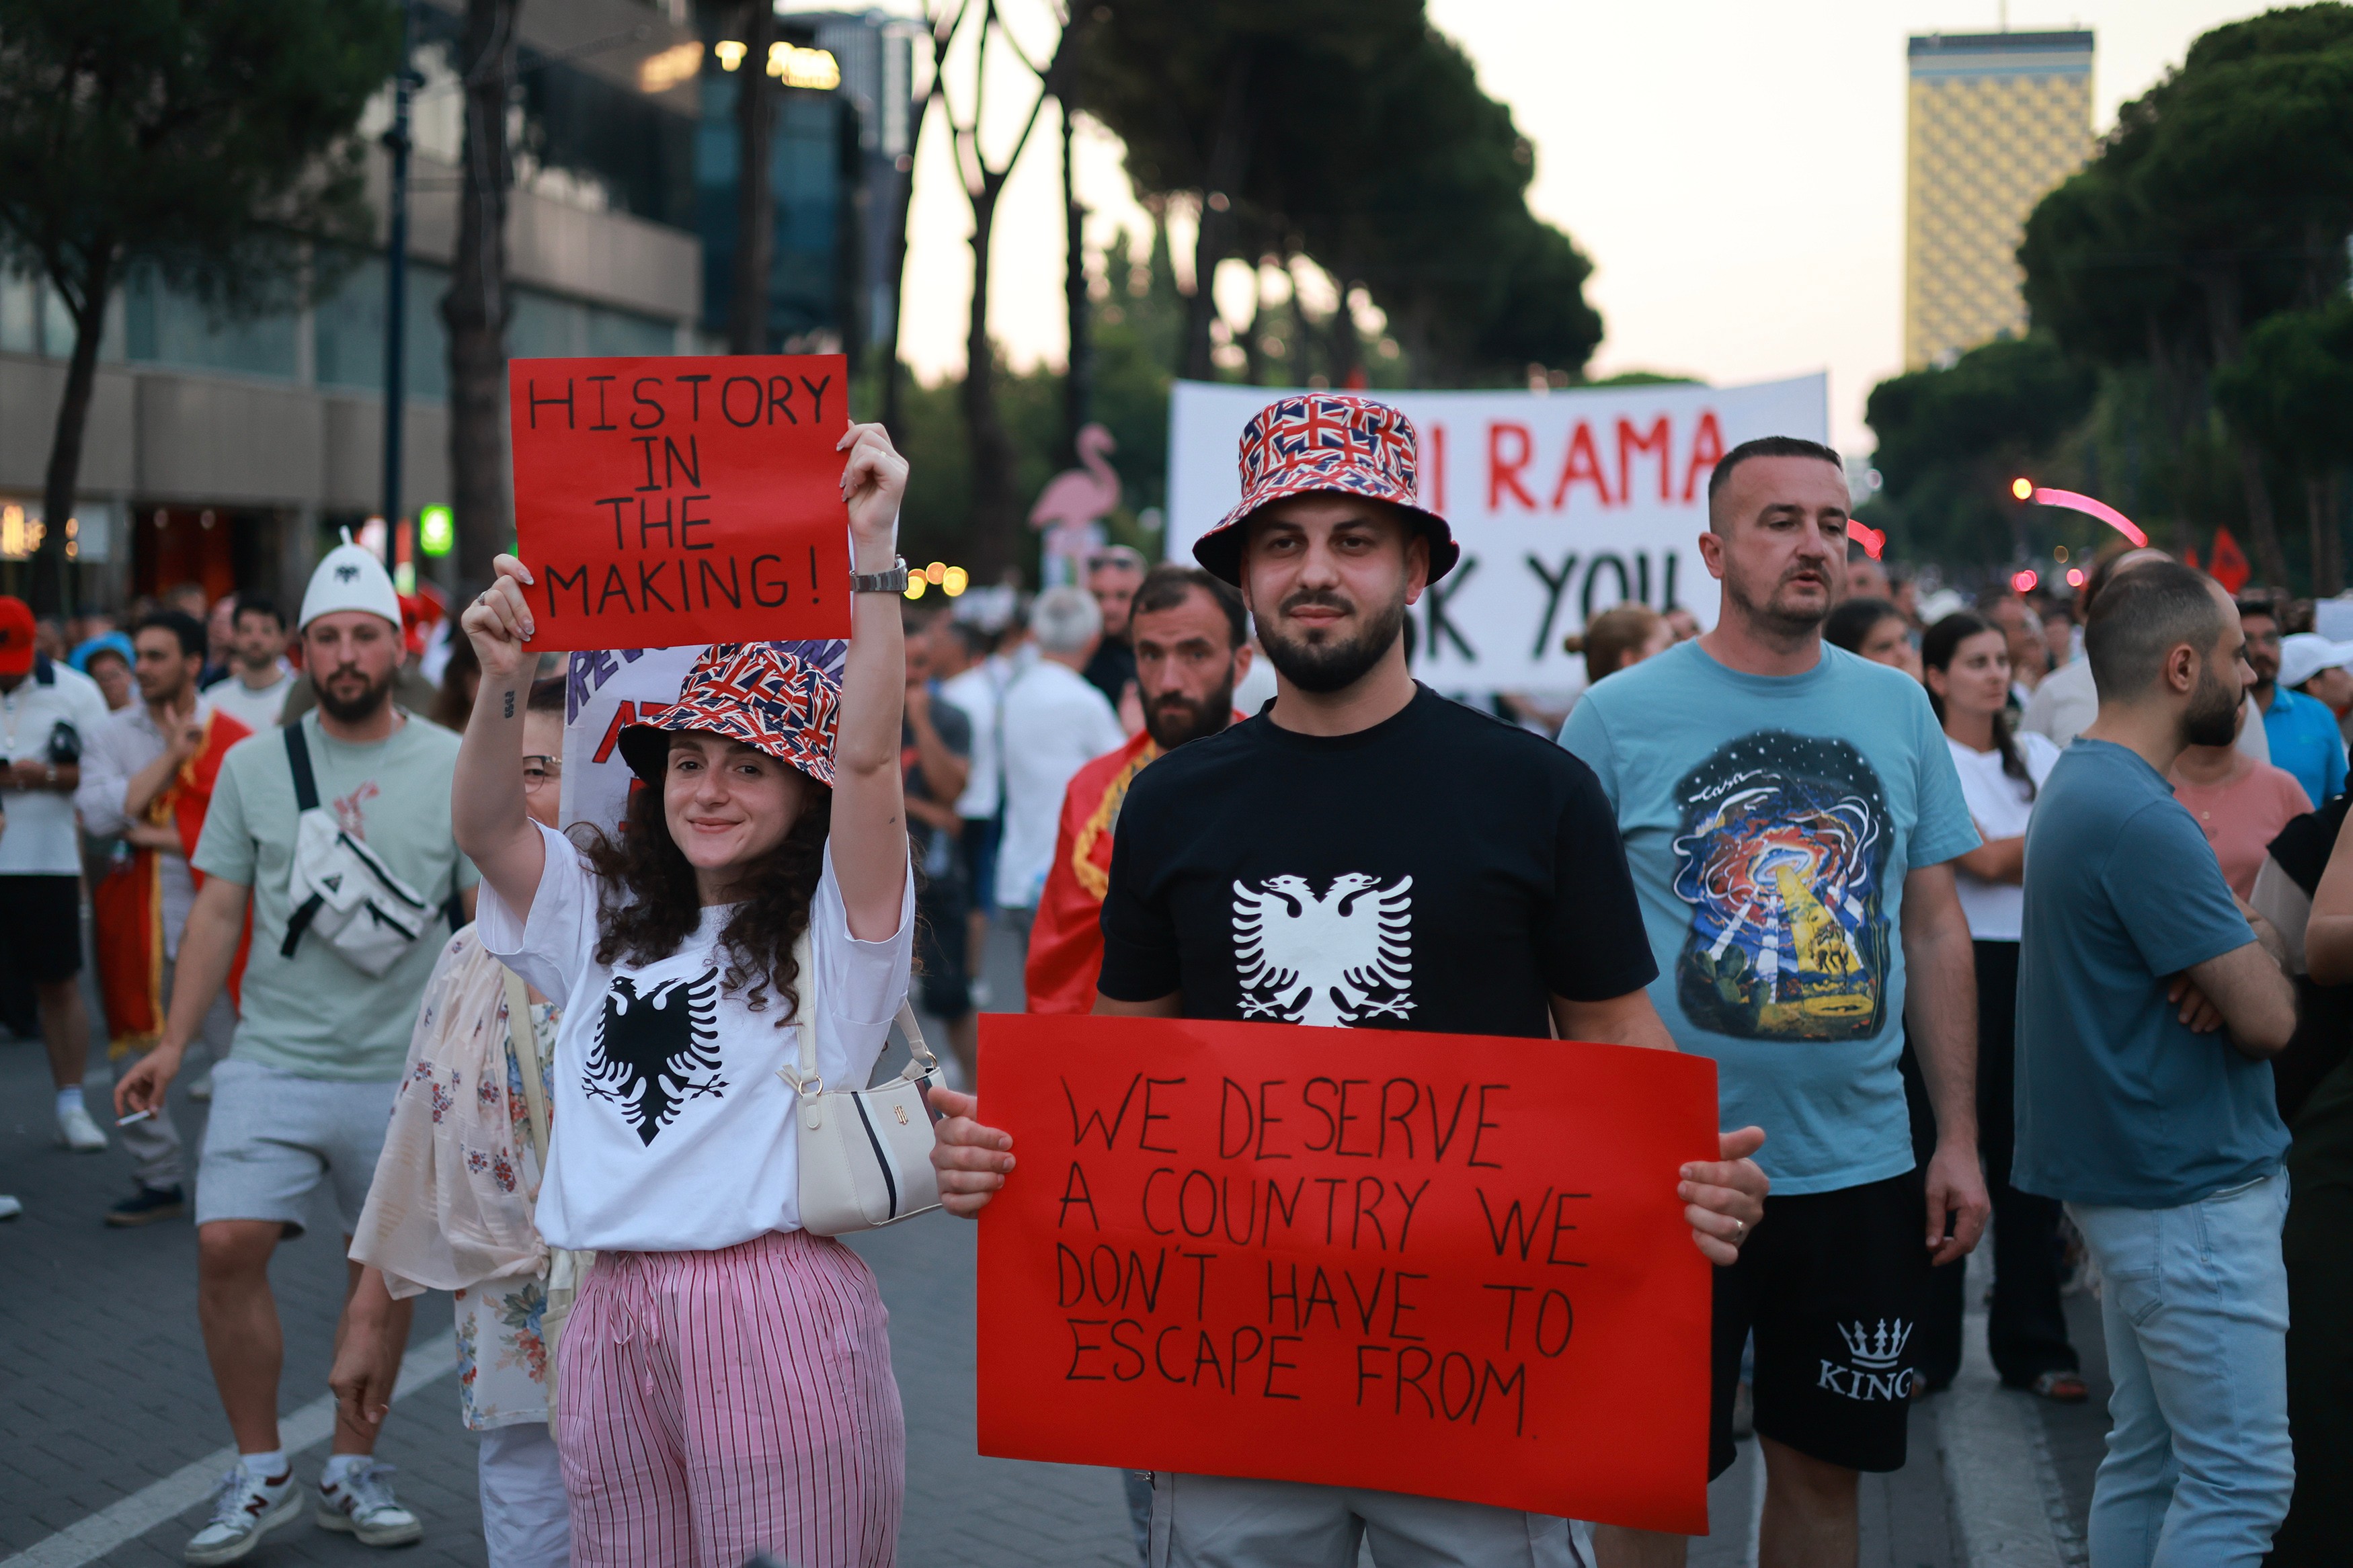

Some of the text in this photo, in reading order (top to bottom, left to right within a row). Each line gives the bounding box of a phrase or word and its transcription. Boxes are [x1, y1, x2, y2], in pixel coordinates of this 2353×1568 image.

[528, 374, 832, 431] HISTORY
[630, 434, 702, 493] IN
[1489, 411, 1725, 511] RAMA
[594, 494, 715, 551] THE
[544, 544, 820, 618] MAKING!
[1061, 1072, 1511, 1169] WE DESERVE
[1058, 1161, 1593, 1268] A COUNTRY WE
[1056, 1241, 1574, 1358] DON'T HAVE TO
[1065, 1318, 1304, 1401] ESCAPE
[1817, 1358, 1914, 1402] KING
